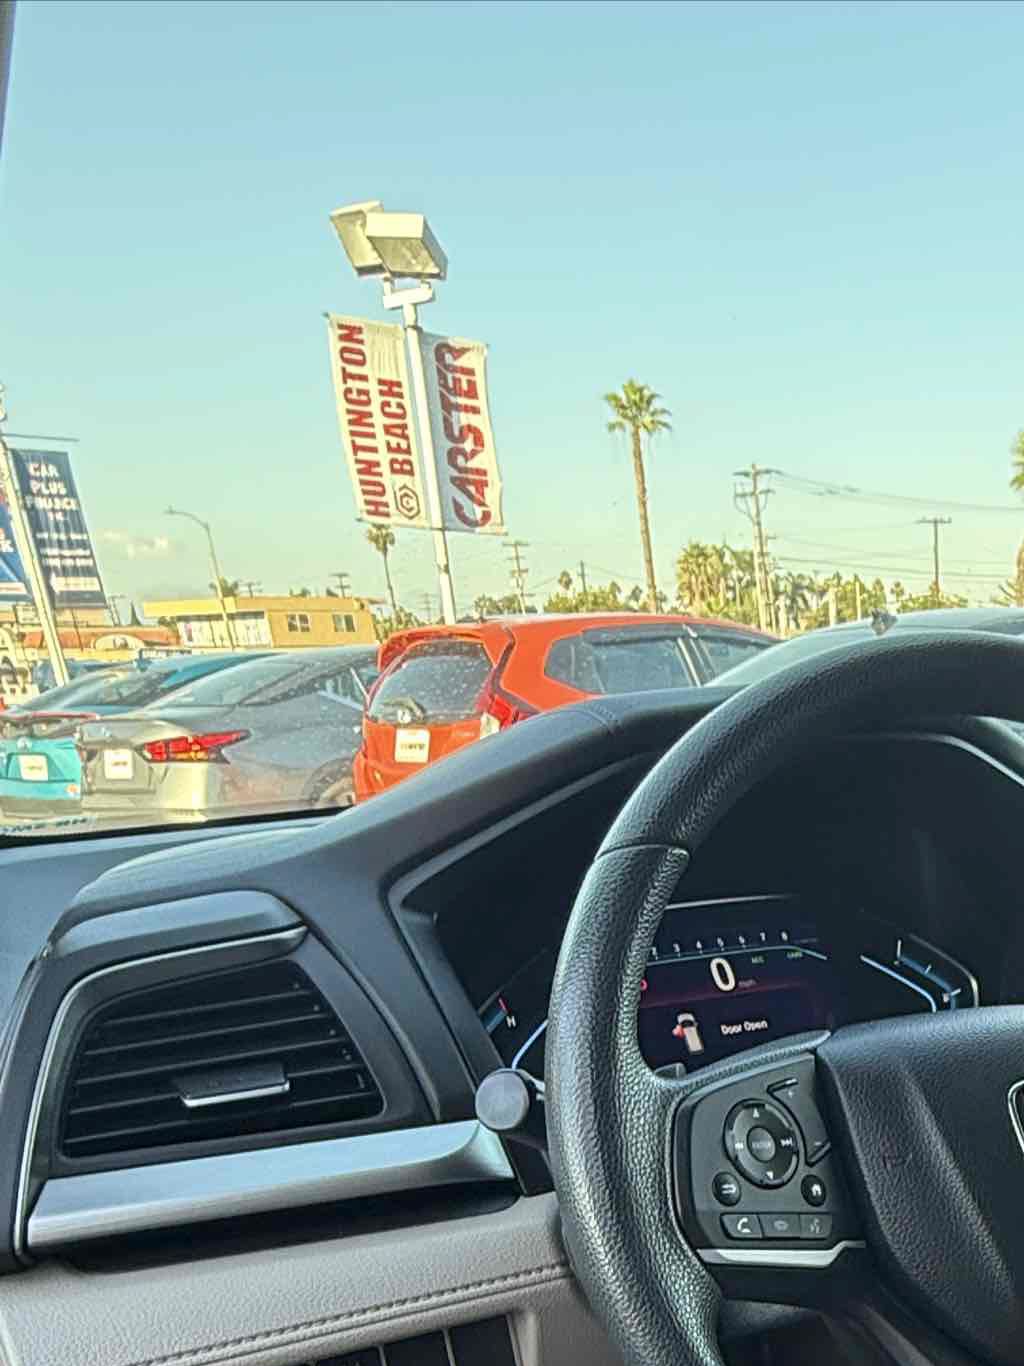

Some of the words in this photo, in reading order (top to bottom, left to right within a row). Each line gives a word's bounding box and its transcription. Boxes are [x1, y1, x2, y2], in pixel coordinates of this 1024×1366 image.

[337, 323, 391, 518] HUNTINGTON
[377, 377, 415, 478] BEACH
[433, 341, 492, 528] CARSTER
[28, 463, 60, 478] CAR
[709, 957, 736, 992] 0
[720, 1024, 743, 1036] Door
[743, 1019, 768, 1031] Open
